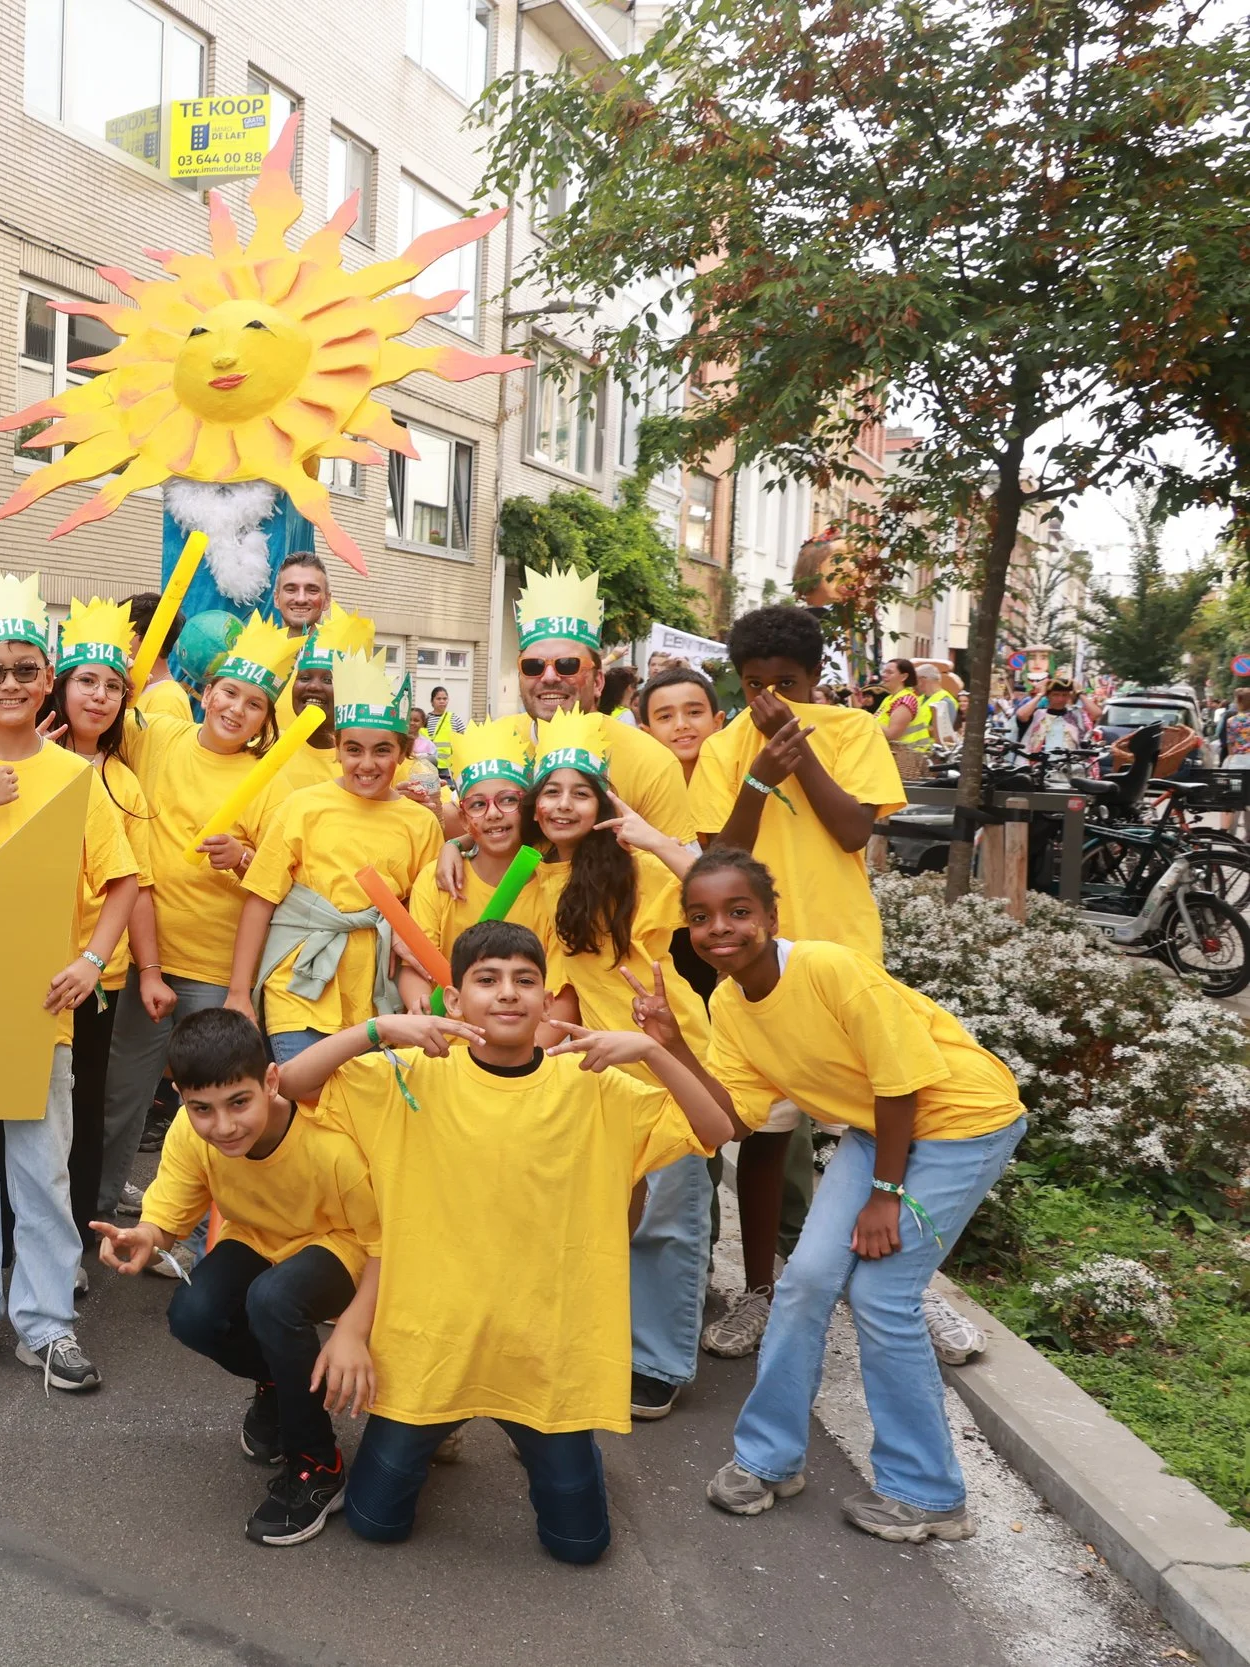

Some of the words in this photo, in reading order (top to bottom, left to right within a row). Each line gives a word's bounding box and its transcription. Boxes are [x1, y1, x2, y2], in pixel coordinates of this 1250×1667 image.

[179, 102, 203, 118] TE
[209, 98, 264, 116] KOOP
[212, 132, 223, 141] DE
[225, 131, 247, 140] LAET
[177, 155, 193, 167] 03
[196, 153, 220, 165] 644
[224, 152, 241, 164] 00
[244, 151, 262, 163] 88
[177, 163, 261, 175] www.immodelaet.be
[547, 616, 579, 636] 314
[86, 642, 115, 662] 314
[236, 659, 268, 685] 314
[336, 704, 357, 725] 314
[545, 747, 576, 769] 314
[469, 758, 500, 780] 314
